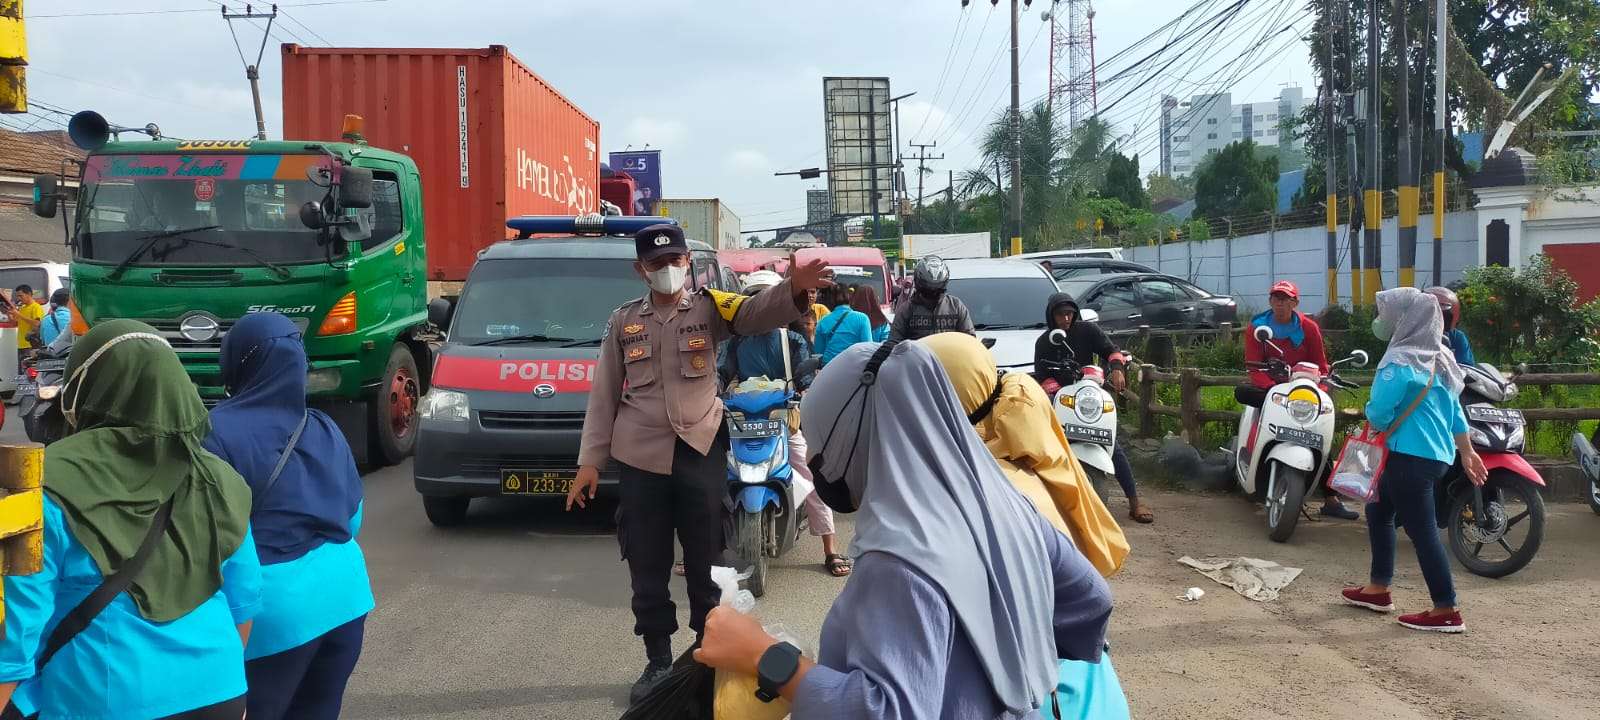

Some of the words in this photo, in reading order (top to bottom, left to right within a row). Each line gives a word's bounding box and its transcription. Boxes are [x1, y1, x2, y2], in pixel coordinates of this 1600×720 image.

[460, 111, 468, 172] 152415
[637, 158, 647, 171] 5
[500, 362, 595, 382] POLISI
